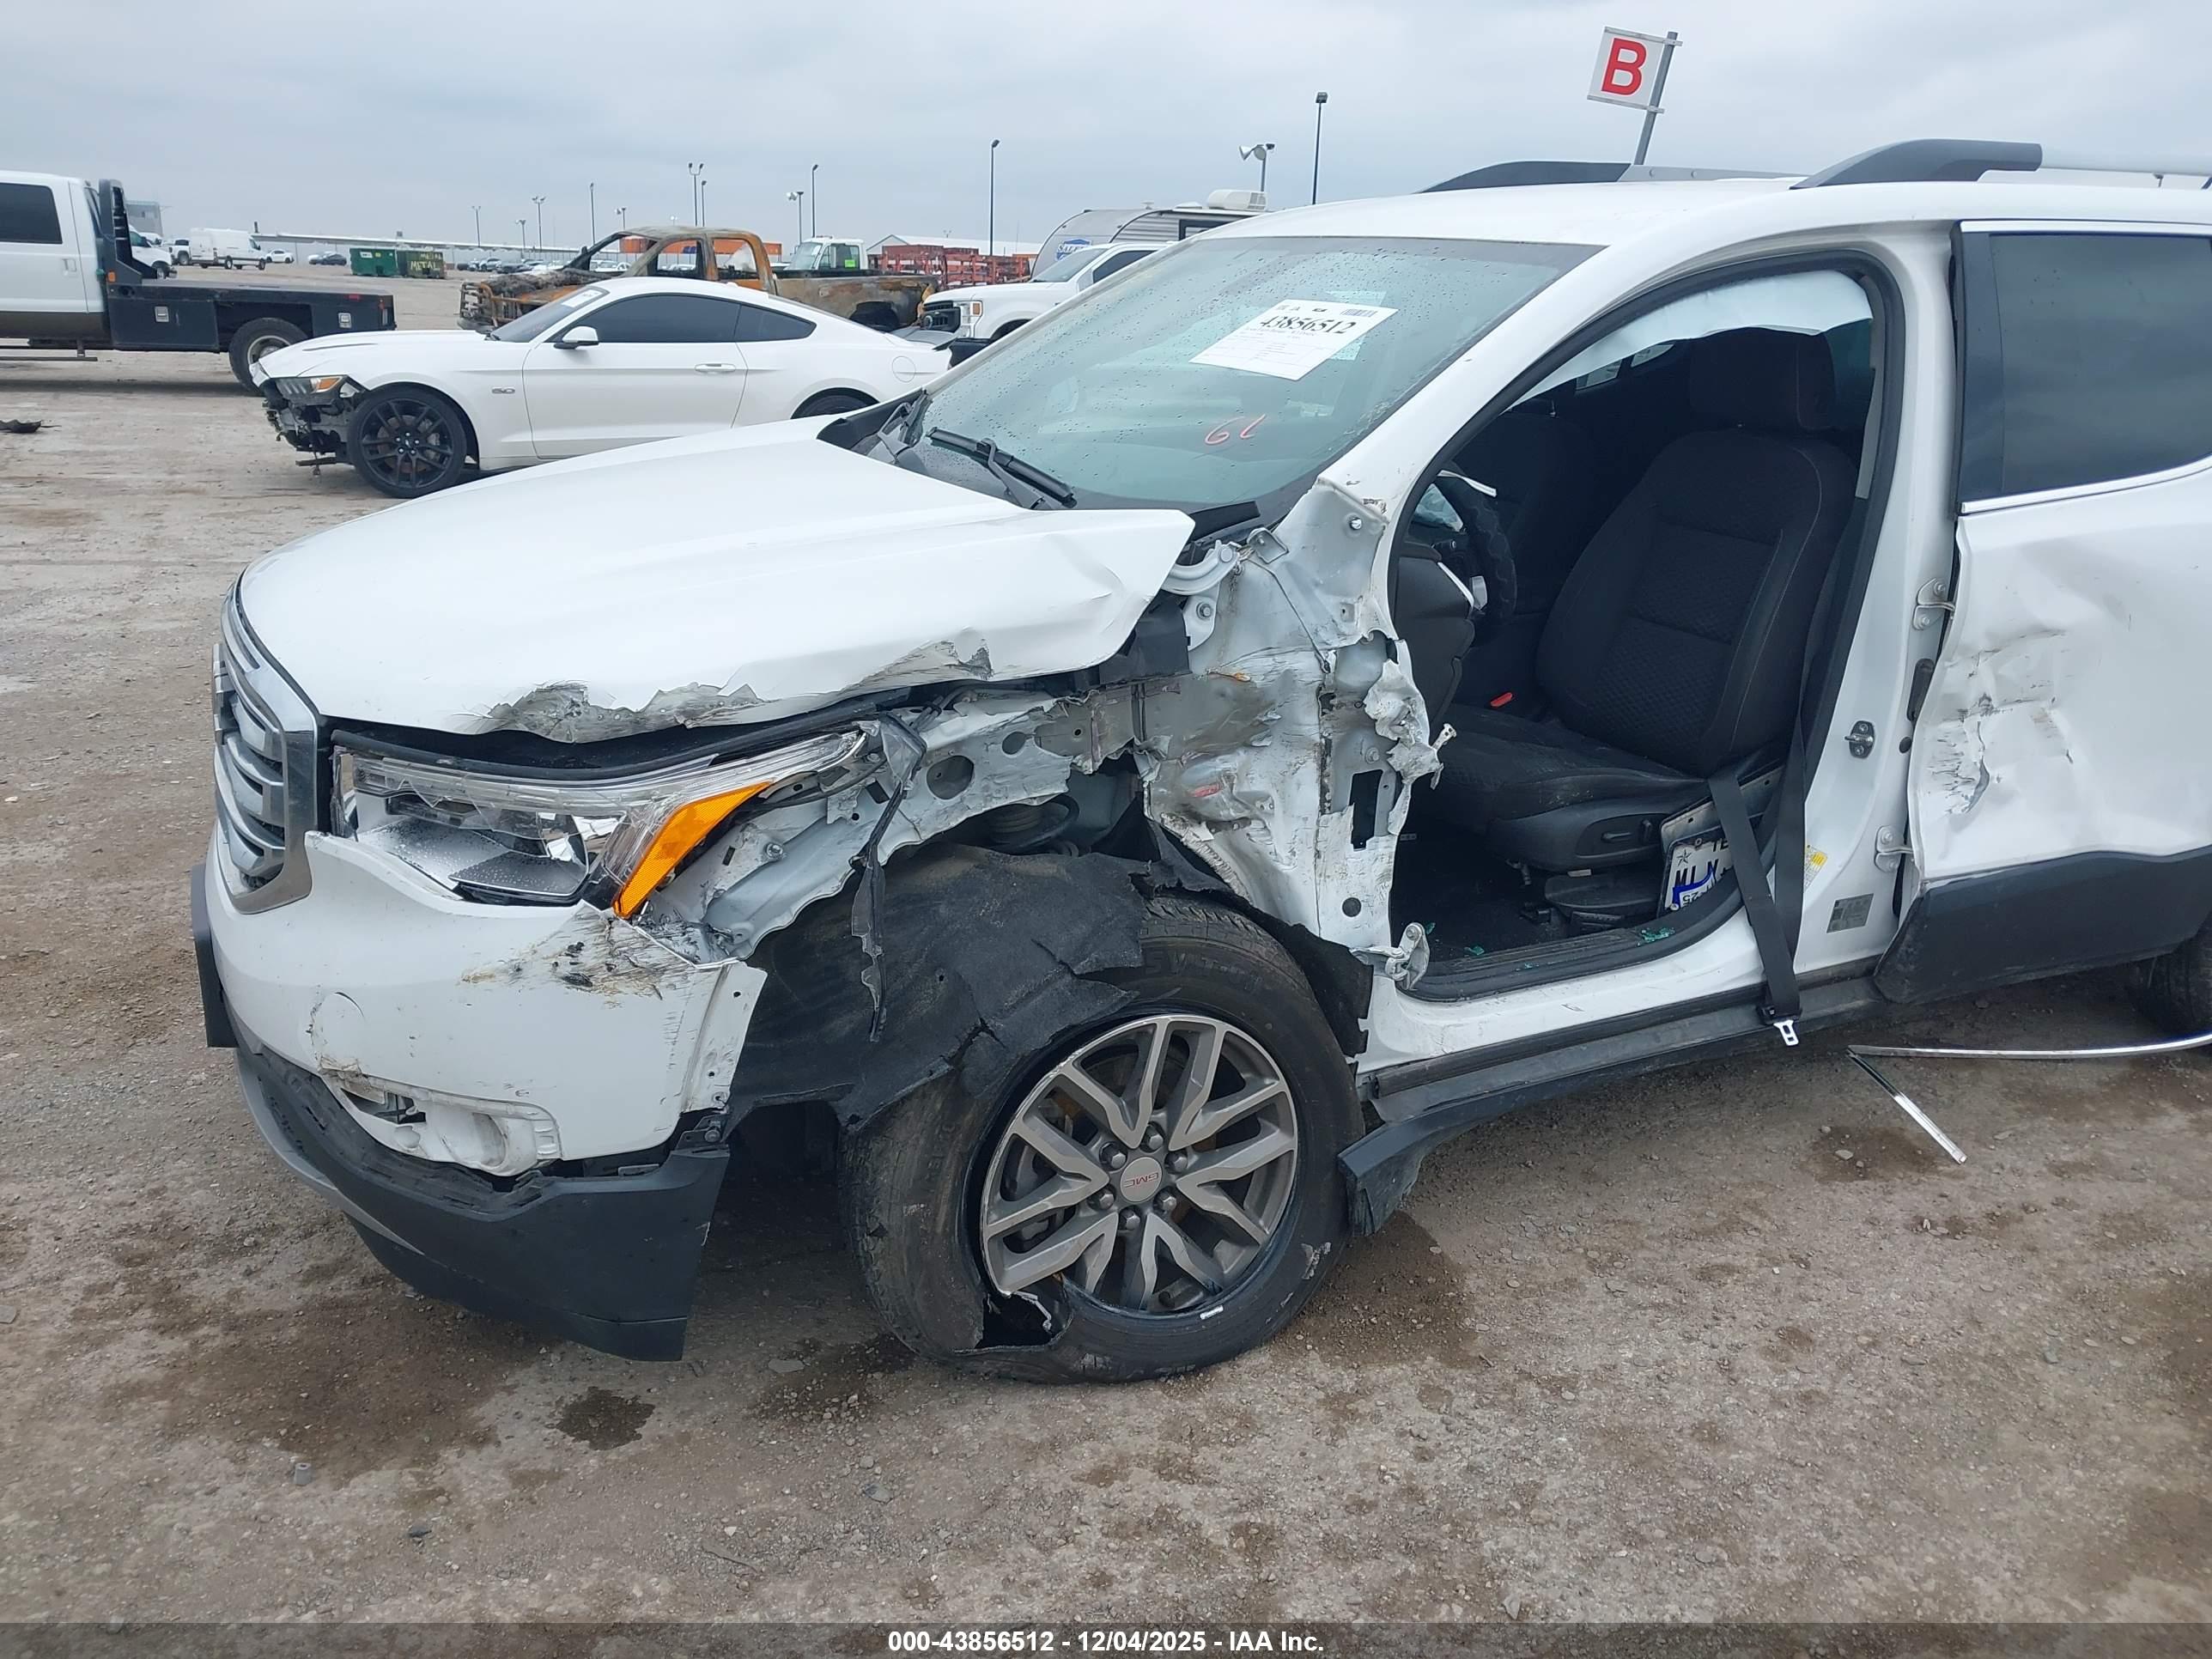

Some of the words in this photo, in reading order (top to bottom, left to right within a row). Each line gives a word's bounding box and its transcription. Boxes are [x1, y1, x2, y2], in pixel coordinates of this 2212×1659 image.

[1601, 37, 1647, 95] B
[410, 260, 441, 271] METAL
[1260, 315, 1357, 334] 43856512
[1123, 1172, 1159, 1188] GMC
